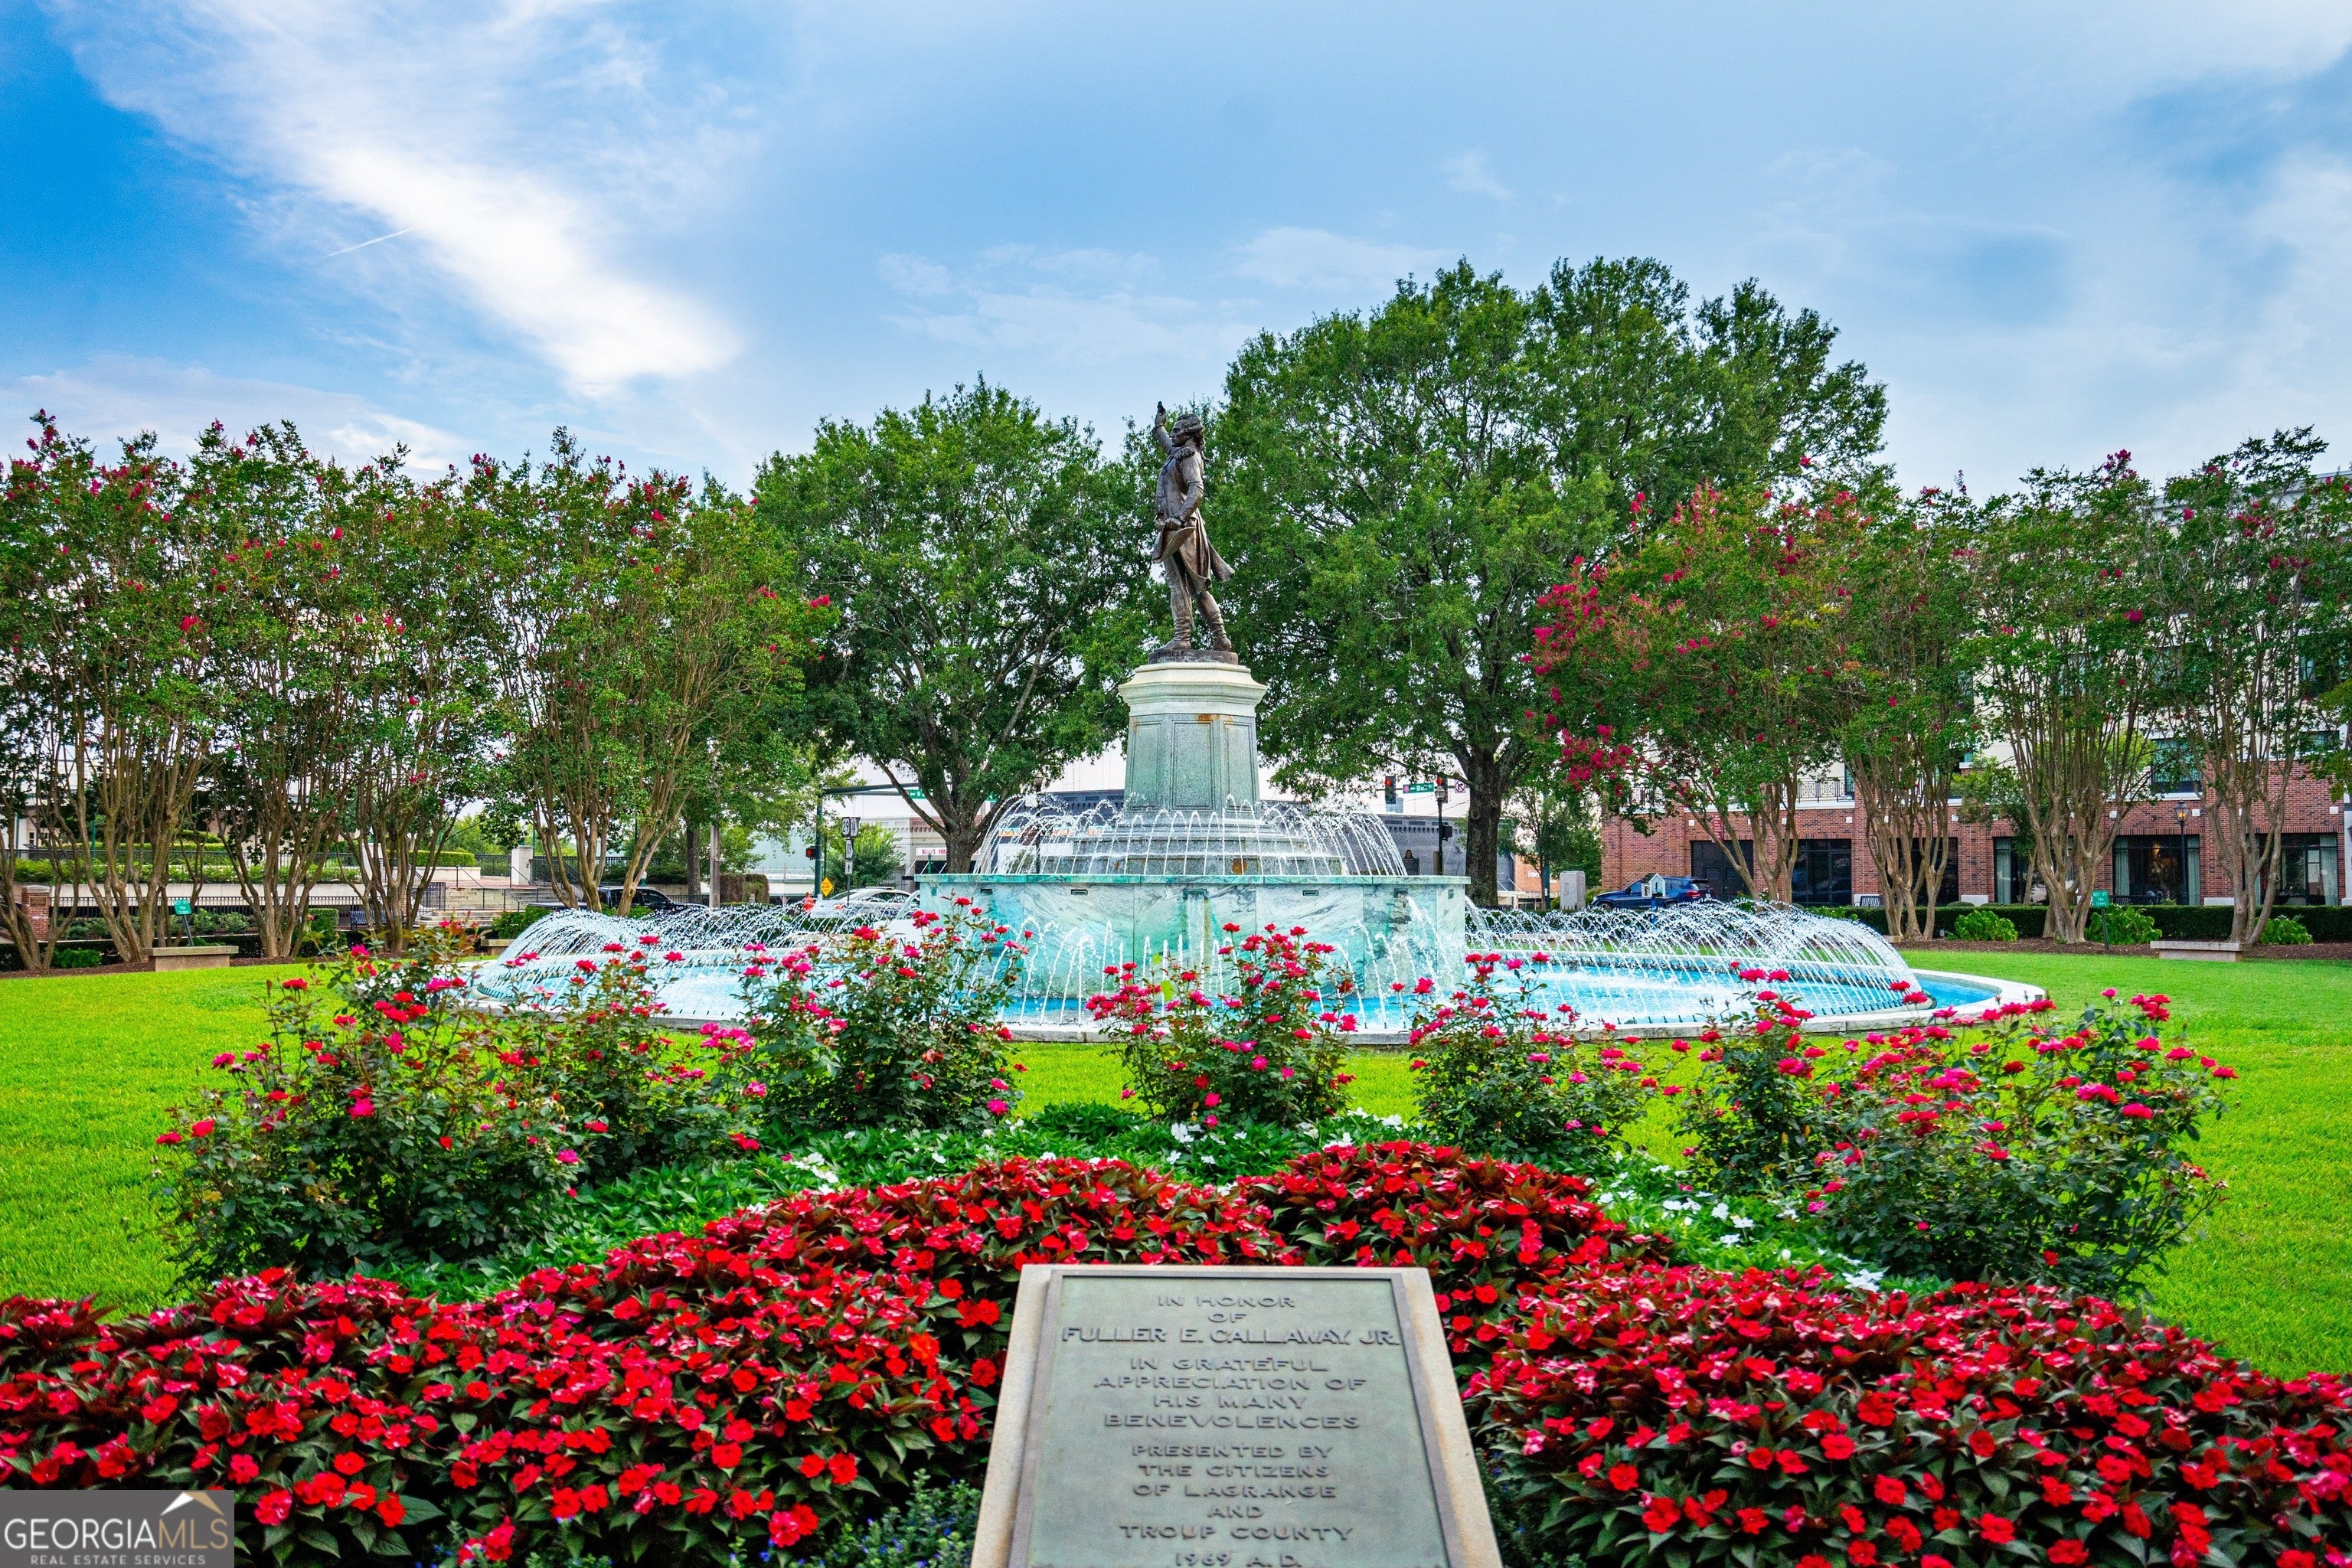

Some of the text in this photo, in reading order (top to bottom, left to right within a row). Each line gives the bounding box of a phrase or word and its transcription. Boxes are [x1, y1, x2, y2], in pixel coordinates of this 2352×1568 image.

[1158, 1295, 1295, 1308] IN HONOR
[1208, 1312, 1247, 1323] OF
[1062, 1327, 1167, 1342] FULLER
[1180, 1328, 1204, 1343] E.
[1359, 1330, 1400, 1346] JR.
[1130, 1358, 1328, 1372] IN GRATEFUL
[1093, 1377, 1367, 1390] APPRECIATION OF
[1153, 1394, 1307, 1409] HIS MANY
[1104, 1415, 1361, 1429] BENEVOLENCES
[1132, 1444, 1334, 1458] PRESENTED BY
[1138, 1465, 1330, 1478] THE CITIZENS
[1132, 1485, 1337, 1498] OF LAGRANGE
[1207, 1506, 1264, 1518] AND
[1119, 1525, 1353, 1540] TROUP COUNTY
[1176, 1552, 1231, 1566] 1969
